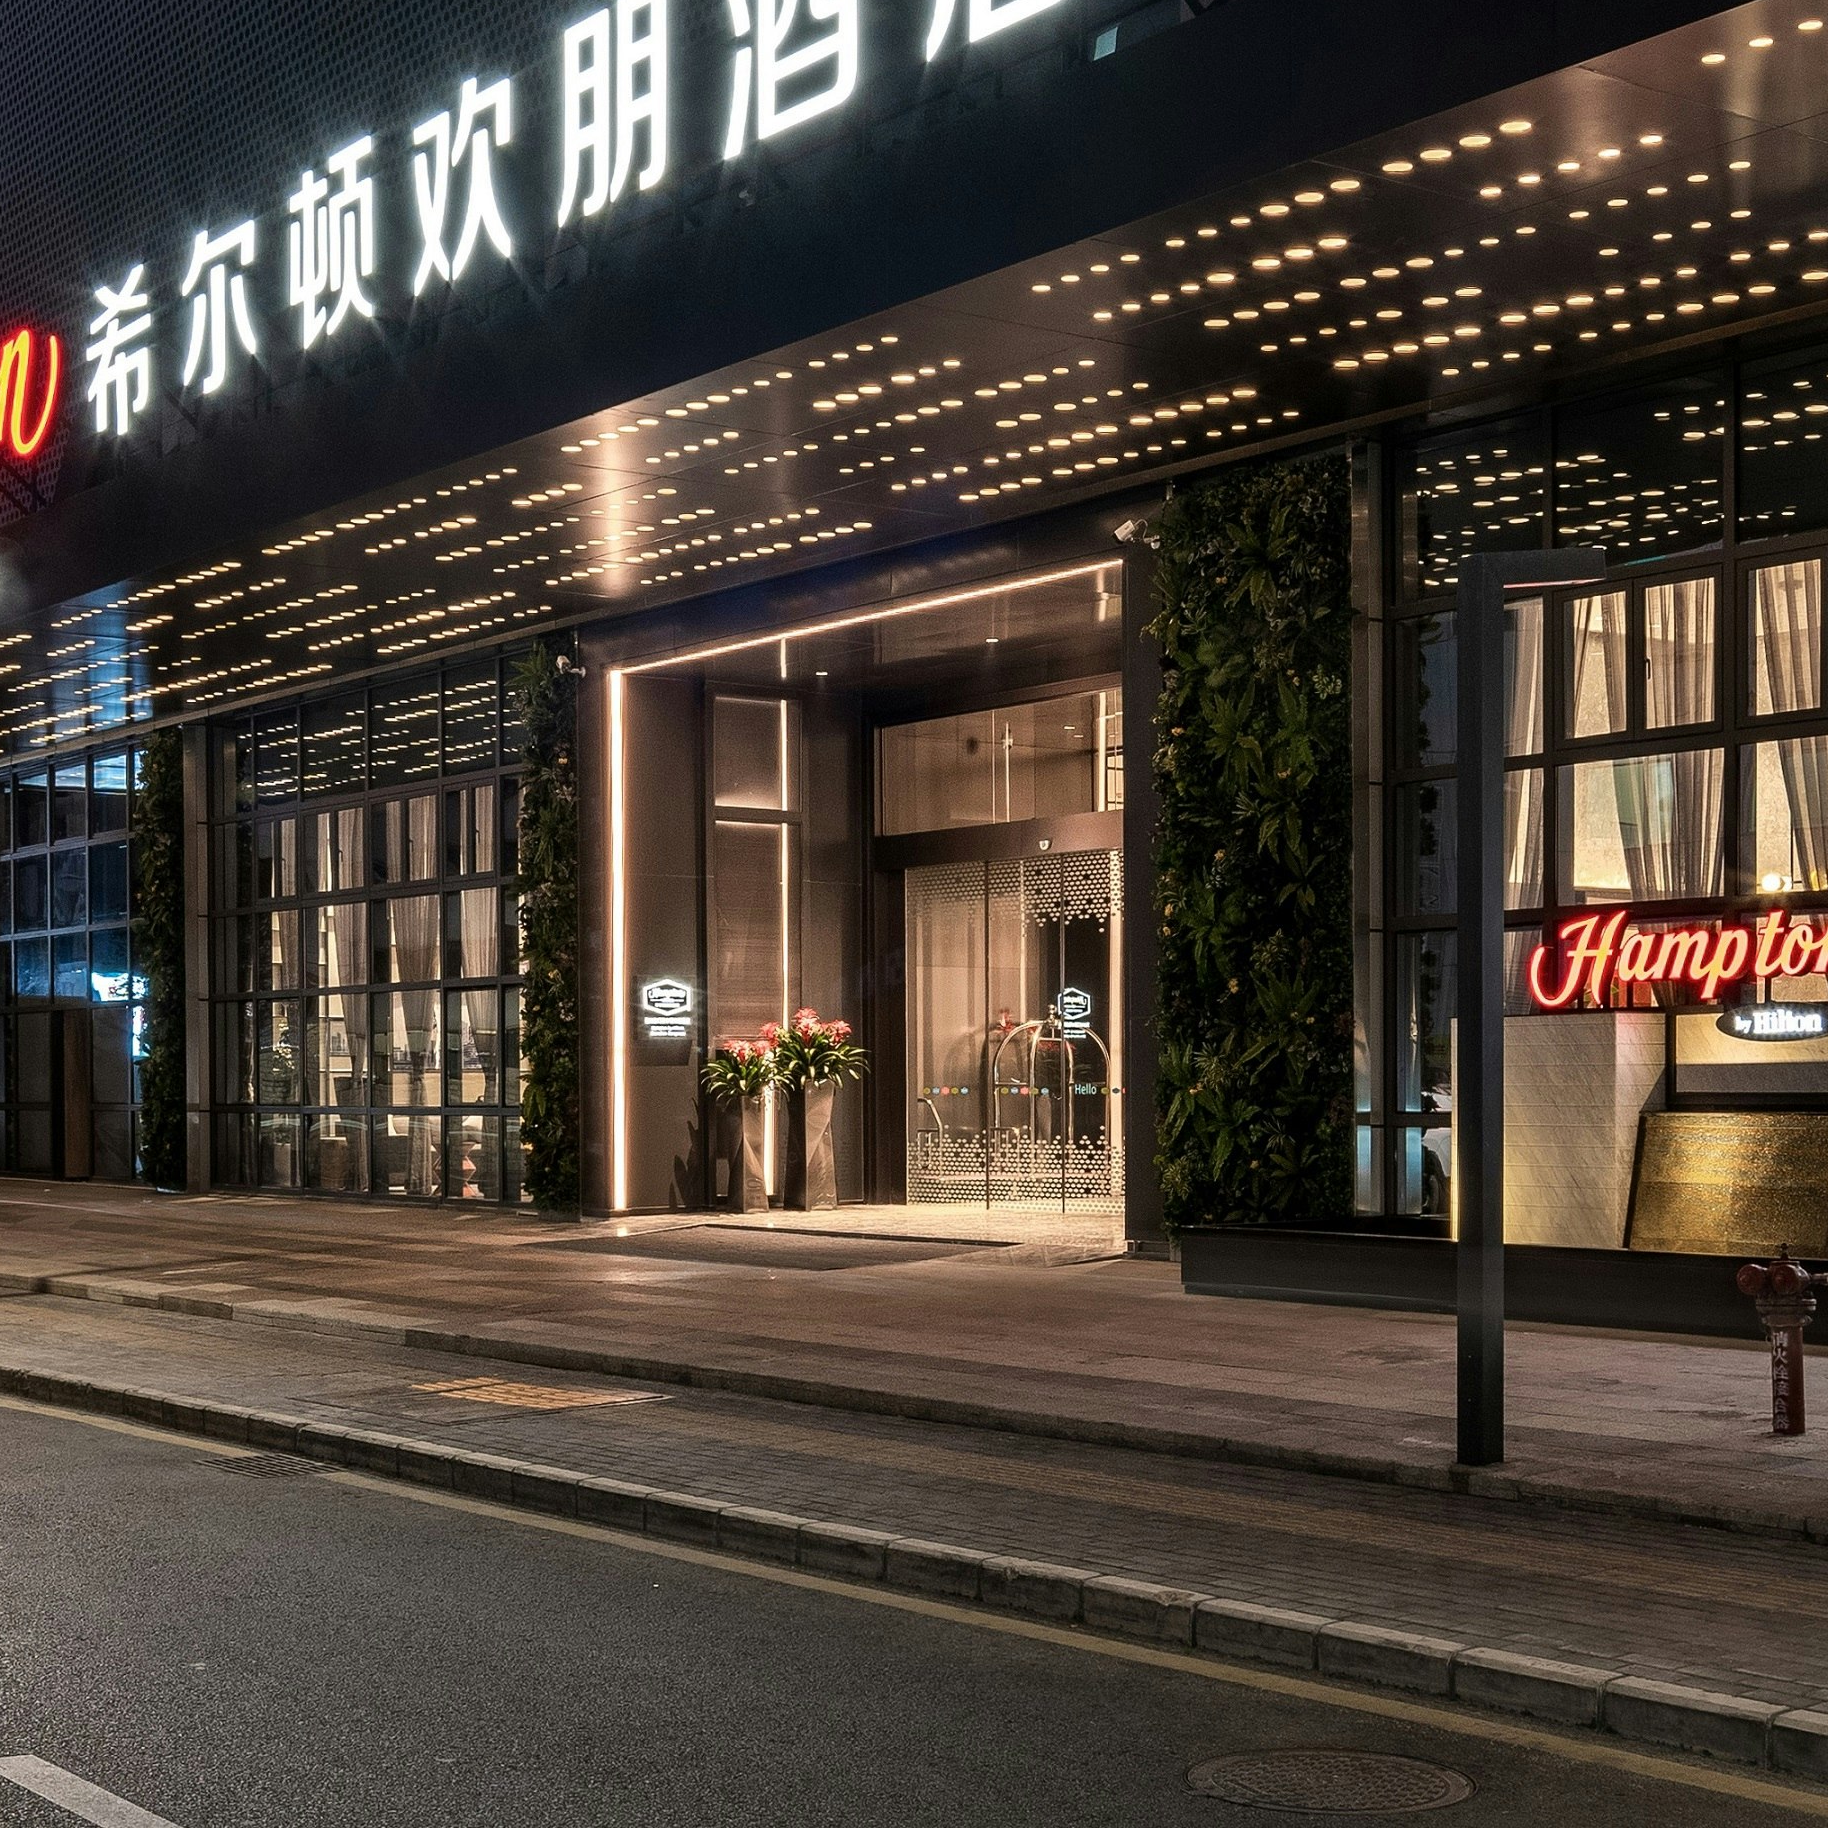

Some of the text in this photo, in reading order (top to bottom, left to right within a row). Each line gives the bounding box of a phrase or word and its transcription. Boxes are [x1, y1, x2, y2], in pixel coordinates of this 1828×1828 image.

[1734, 1009, 1823, 1035] by Hilton
[1074, 1083, 1097, 1096] Hello
